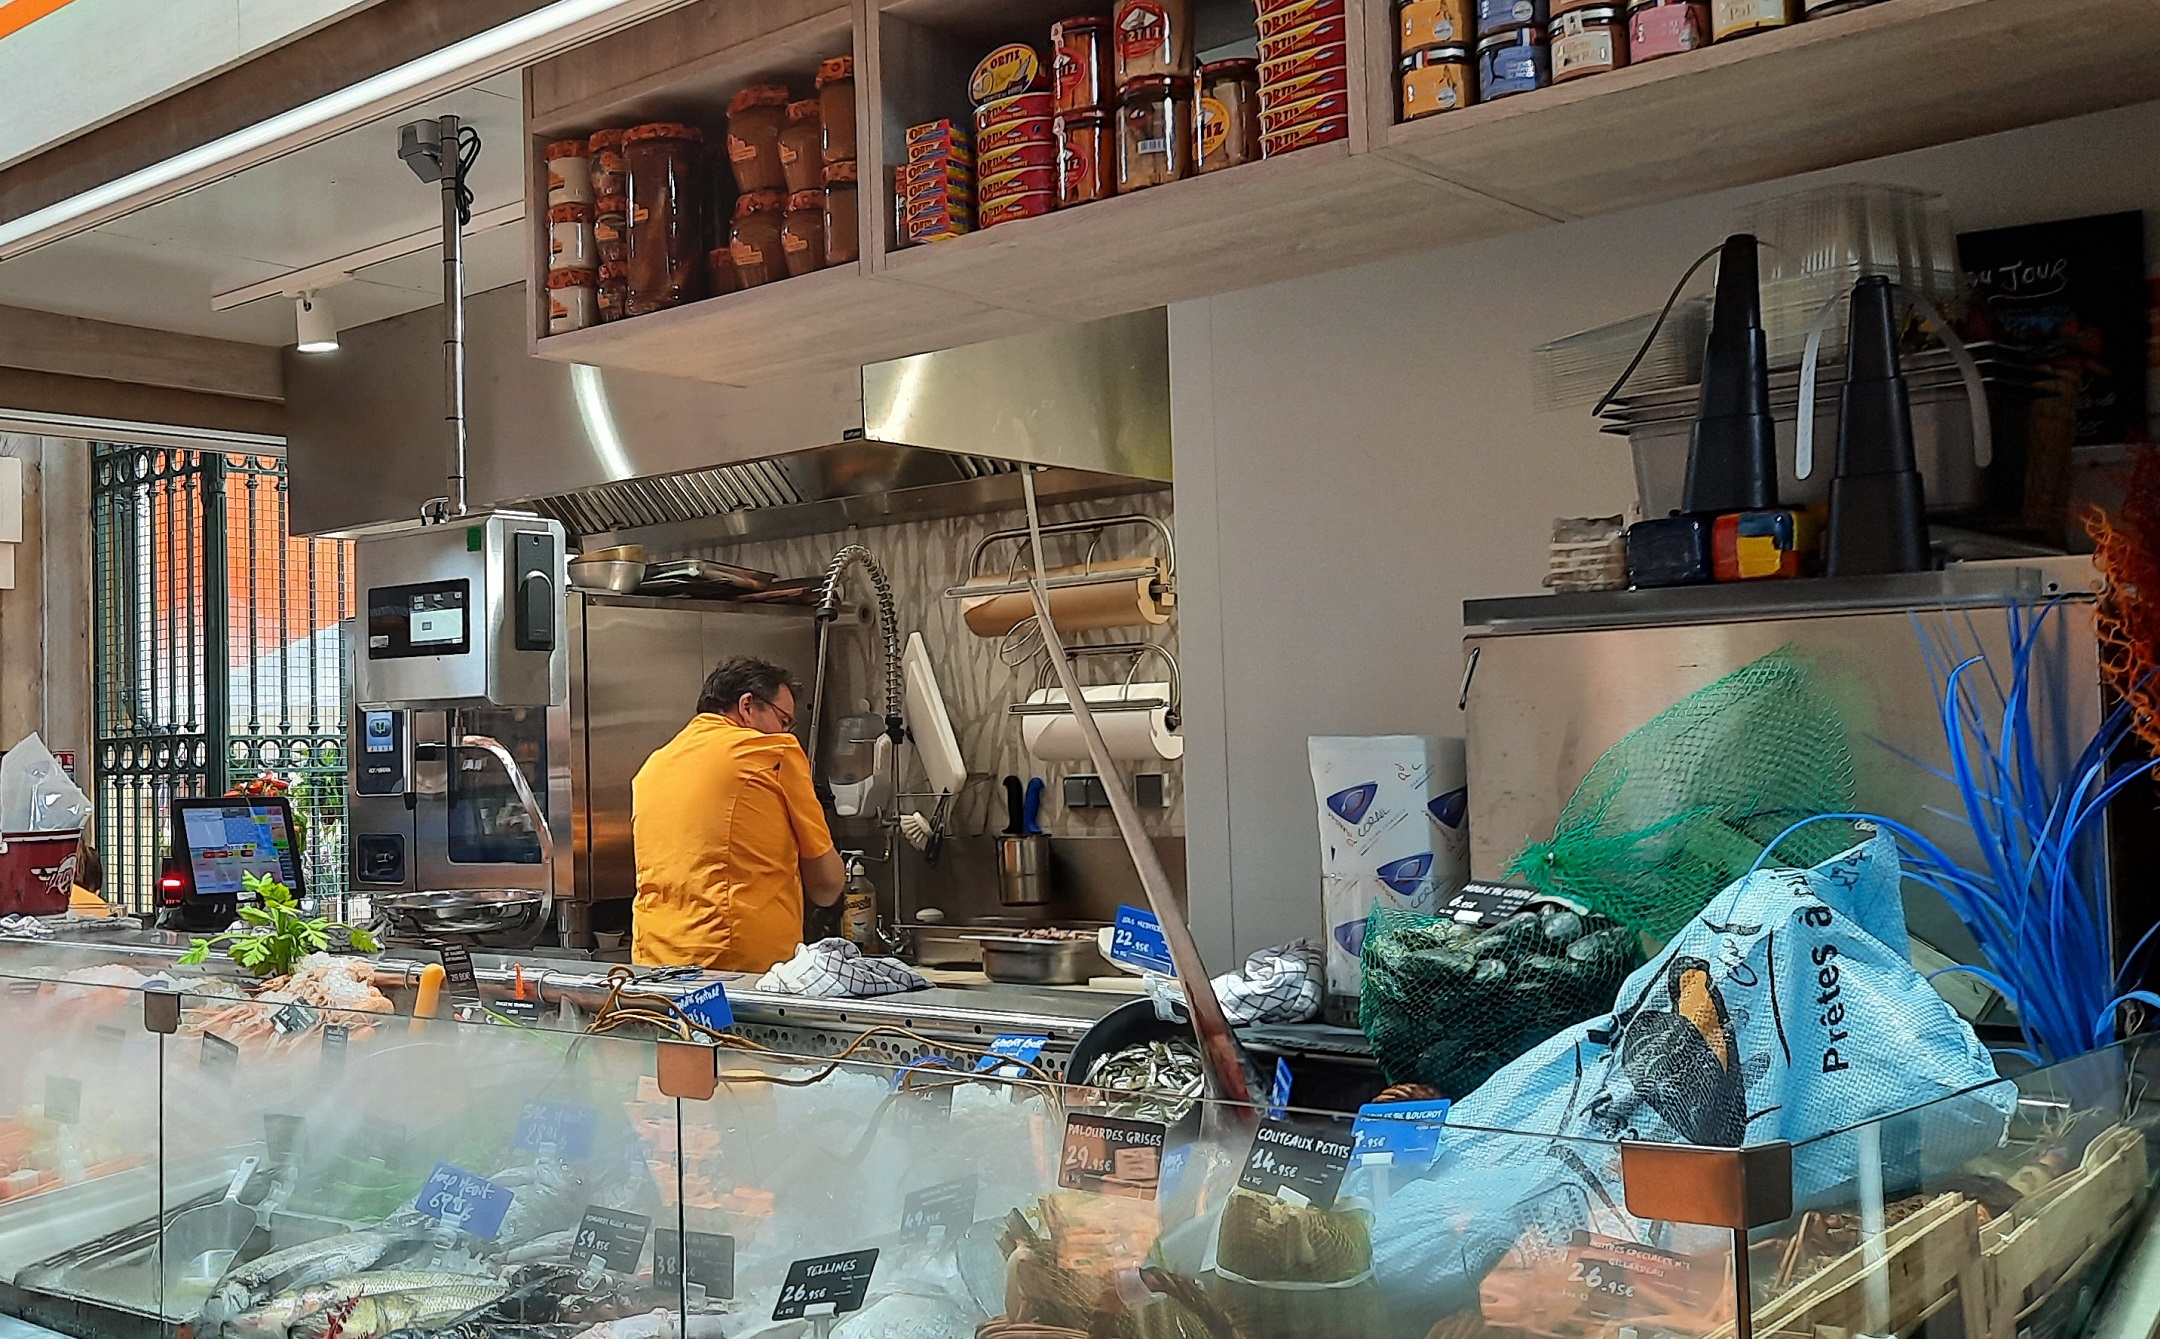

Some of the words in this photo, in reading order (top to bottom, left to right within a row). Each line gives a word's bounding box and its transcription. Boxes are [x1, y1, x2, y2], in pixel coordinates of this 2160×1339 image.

[1797, 906, 1833, 928] à
[1811, 944, 1849, 1074] Prêtes
[1067, 1123, 1123, 1141] PALOURDES
[1126, 1131, 1162, 1147] GRISES
[1257, 1127, 1314, 1152] COUTEAUX
[1314, 1140, 1351, 1159] PETITS
[1064, 1145, 1113, 1172] 29.95€
[1251, 1148, 1299, 1178] 14.95€
[806, 1258, 857, 1278] TELLINES
[781, 1283, 828, 1304] 26.95€
